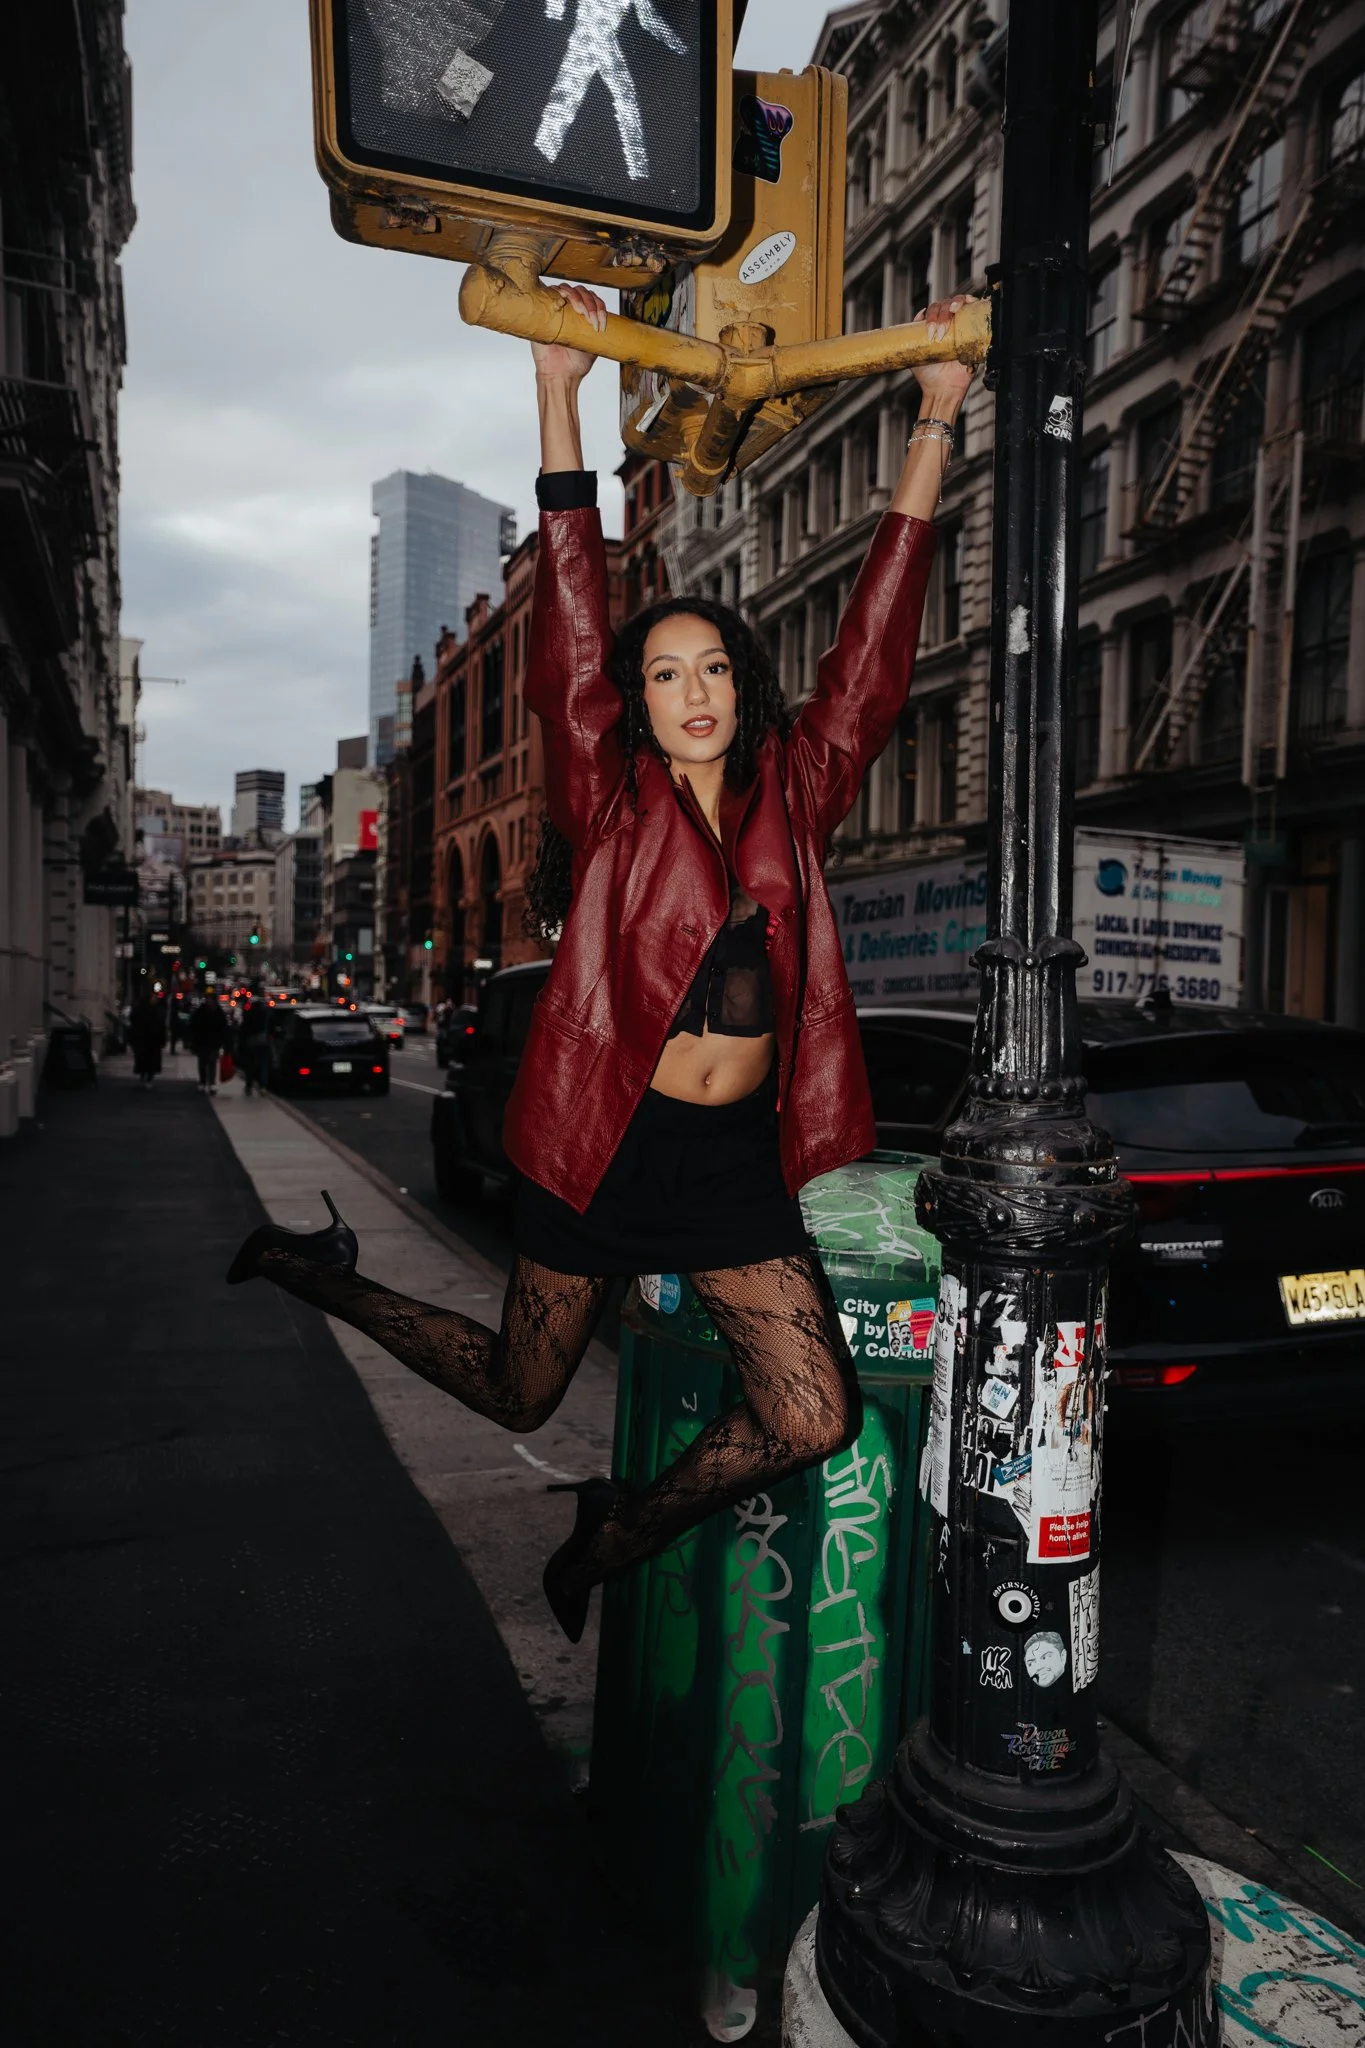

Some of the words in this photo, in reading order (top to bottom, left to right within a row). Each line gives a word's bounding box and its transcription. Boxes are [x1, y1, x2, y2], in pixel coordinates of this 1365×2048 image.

[742, 233, 791, 280] ASSEMBLY
[1181, 868, 1222, 889] Moving
[843, 889, 905, 925] Tarzian
[914, 872, 988, 916] Moving
[1095, 913, 1129, 935] LOCAL
[1173, 920, 1222, 942] DISTANCE
[858, 925, 939, 962] Deliveries
[1316, 1193, 1344, 1209] KIA
[1140, 1239, 1224, 1252] SPORTAGE
[843, 1298, 880, 1318] City
[864, 1321, 887, 1340] by
[1049, 1522, 1075, 1532] Please
[1076, 1519, 1089, 1530] help
[1015, 1721, 1068, 1743] Devon
[1000, 1733, 1077, 1757] Rodriguez
